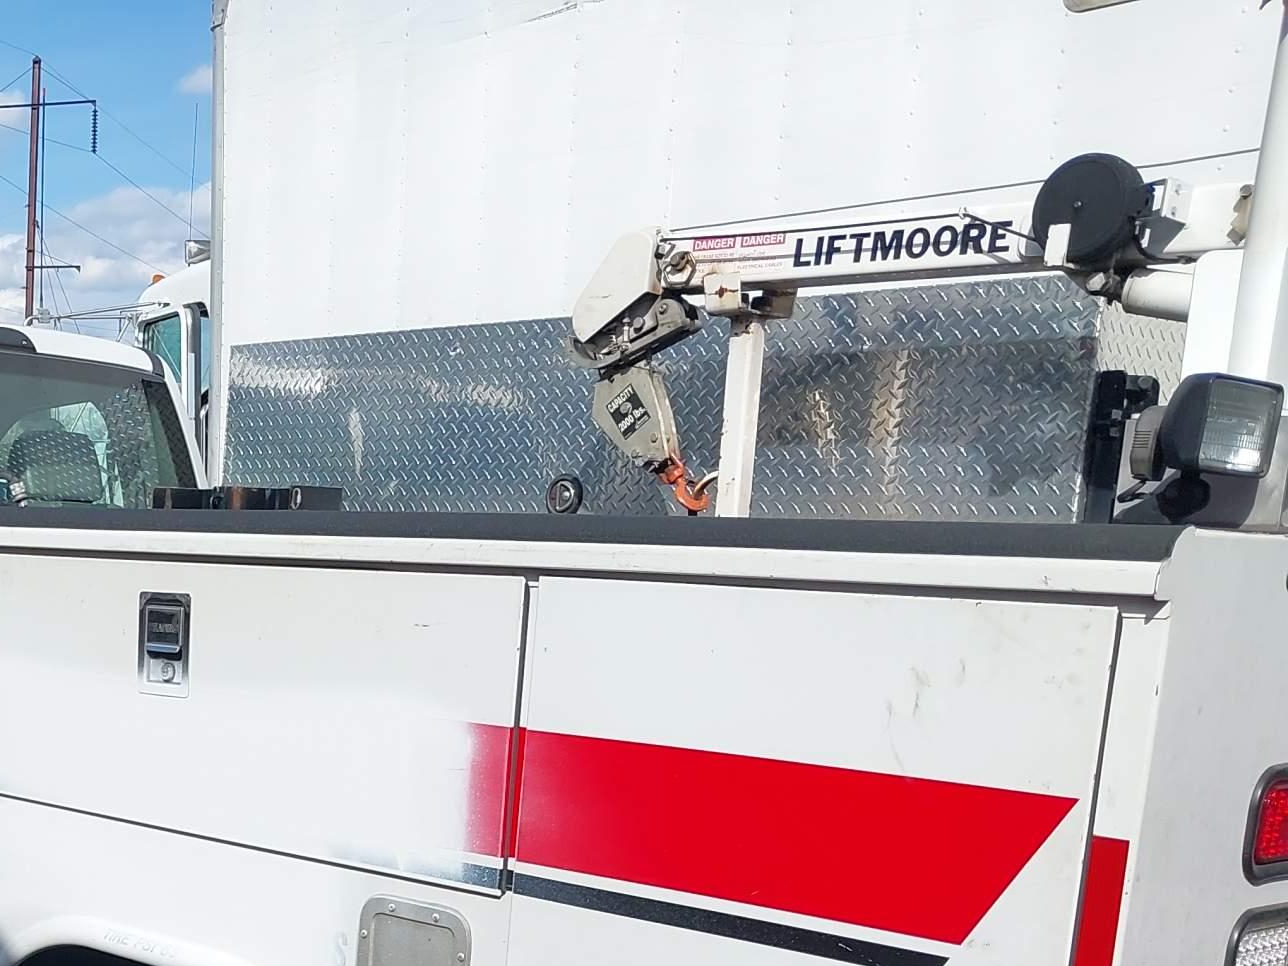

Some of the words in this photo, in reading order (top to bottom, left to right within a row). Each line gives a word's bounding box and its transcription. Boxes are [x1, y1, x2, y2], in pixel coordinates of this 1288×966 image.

[694, 238, 735, 251] DANGER
[742, 233, 785, 246] DANGER
[793, 220, 1013, 268] LIFTMOORE
[607, 386, 635, 413] CAPACITY
[618, 414, 635, 432] 2000
